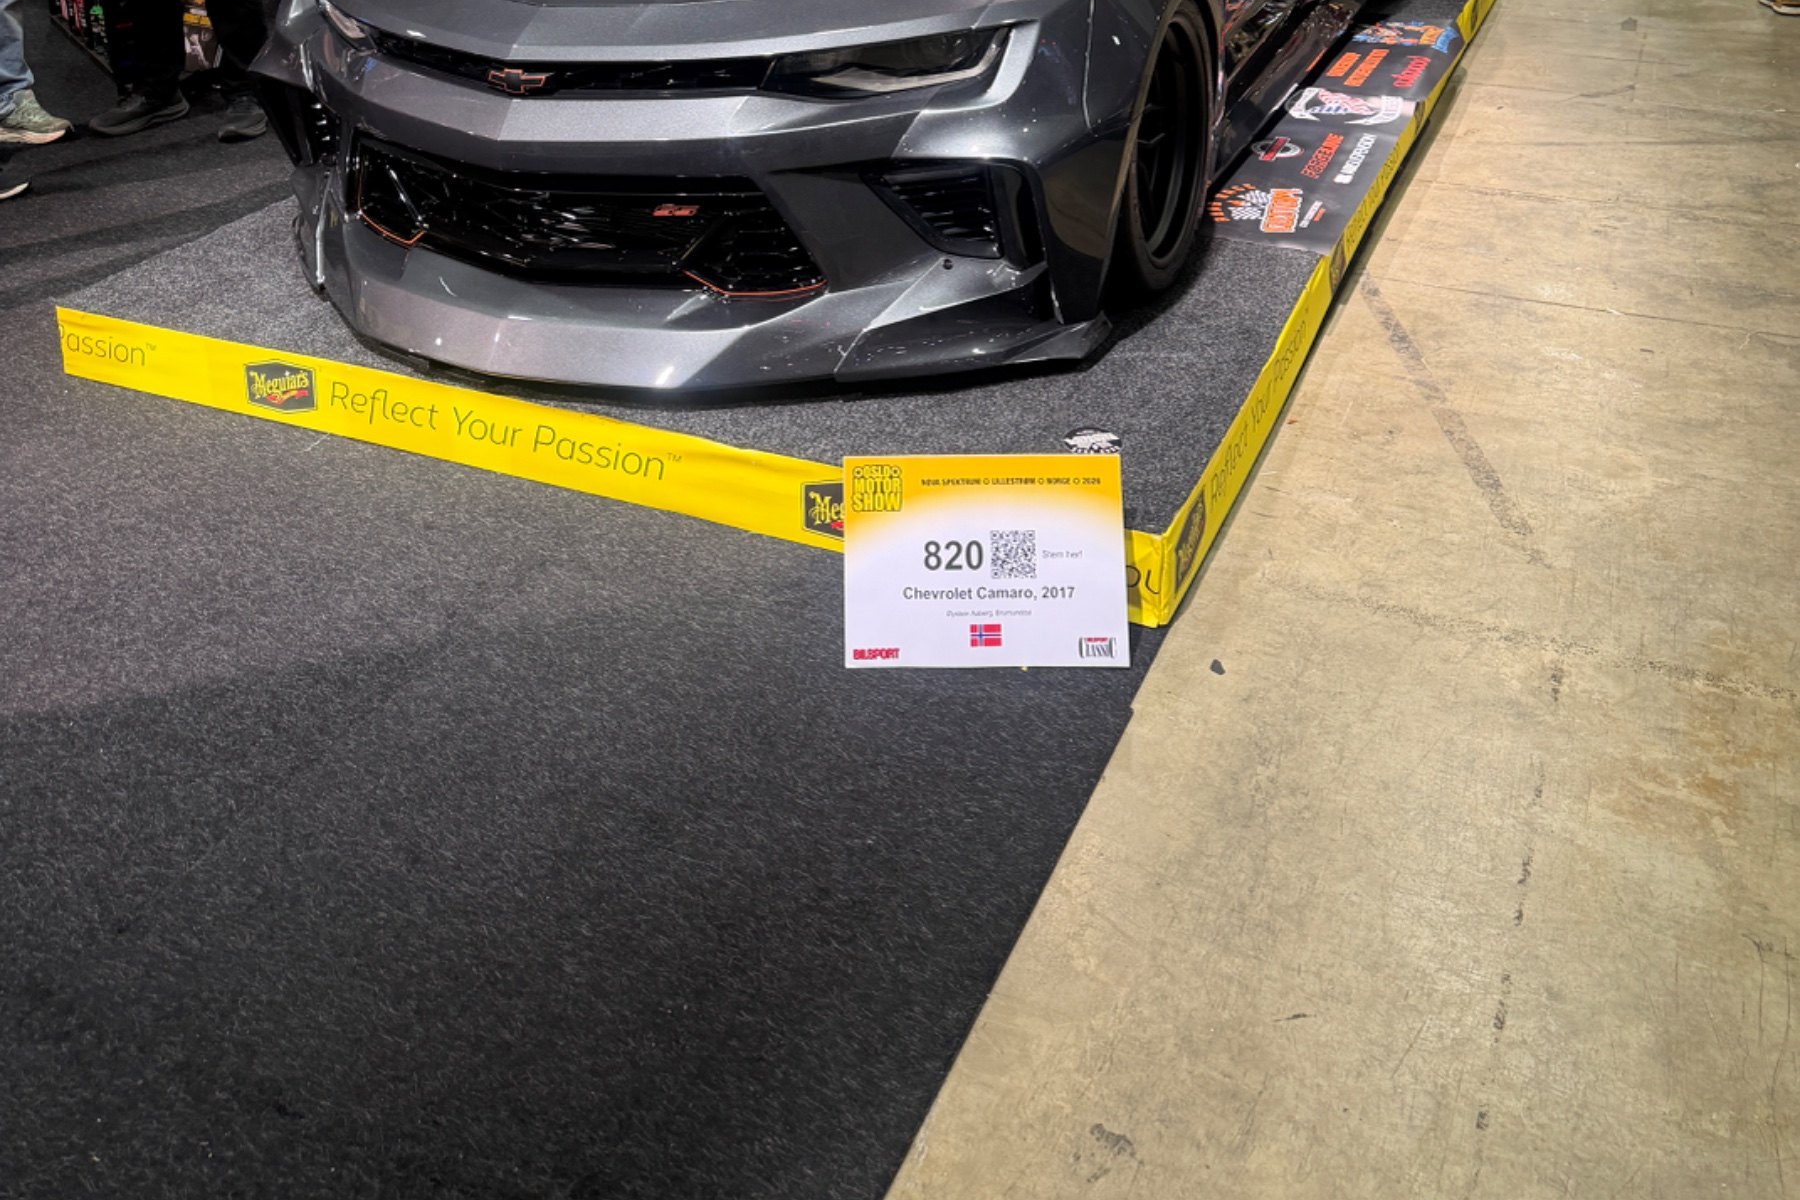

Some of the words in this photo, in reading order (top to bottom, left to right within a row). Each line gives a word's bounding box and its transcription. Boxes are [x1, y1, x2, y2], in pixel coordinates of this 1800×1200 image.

[250, 370, 310, 401] Meguiar's
[330, 380, 439, 431] Reflect
[452, 405, 523, 449] Your
[854, 477, 902, 493] MOTOR
[853, 492, 902, 512] SHOW
[923, 539, 984, 571] 820
[903, 586, 973, 600] Chevrolet
[976, 586, 1037, 601] Camaro,
[1042, 586, 1075, 600] 2017
[853, 648, 900, 660] BILSPORT
